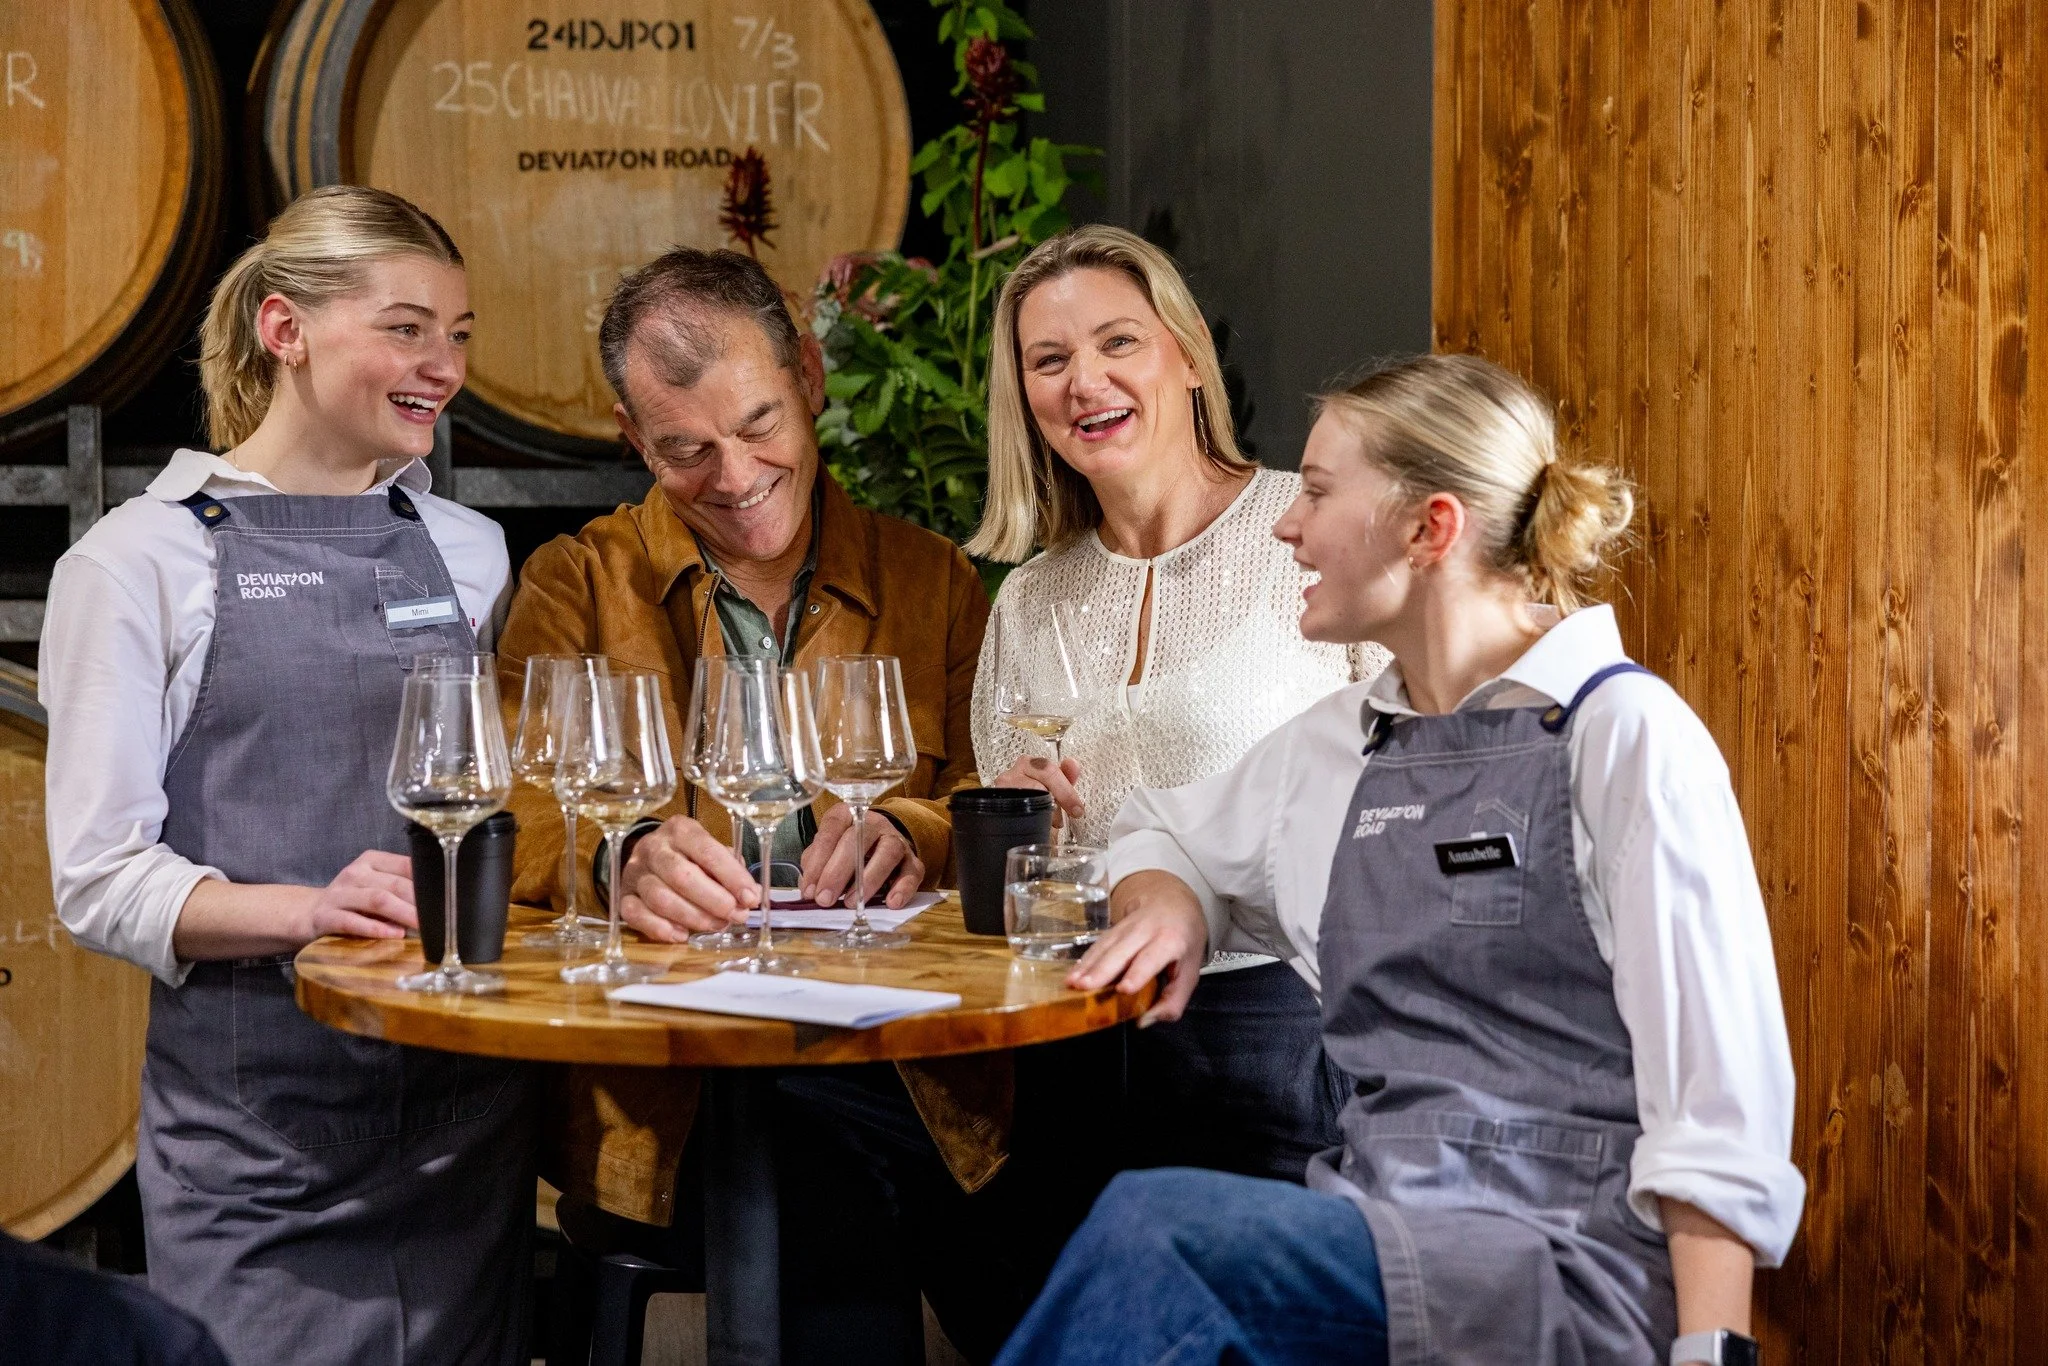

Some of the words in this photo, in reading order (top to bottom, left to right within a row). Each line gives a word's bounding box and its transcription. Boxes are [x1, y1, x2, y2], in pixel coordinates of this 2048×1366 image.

[663, 147, 732, 168] ROAD
[240, 586, 287, 600] ROAD
[1352, 821, 1387, 839] ROAD
[1447, 845, 1503, 864] Annabelle
